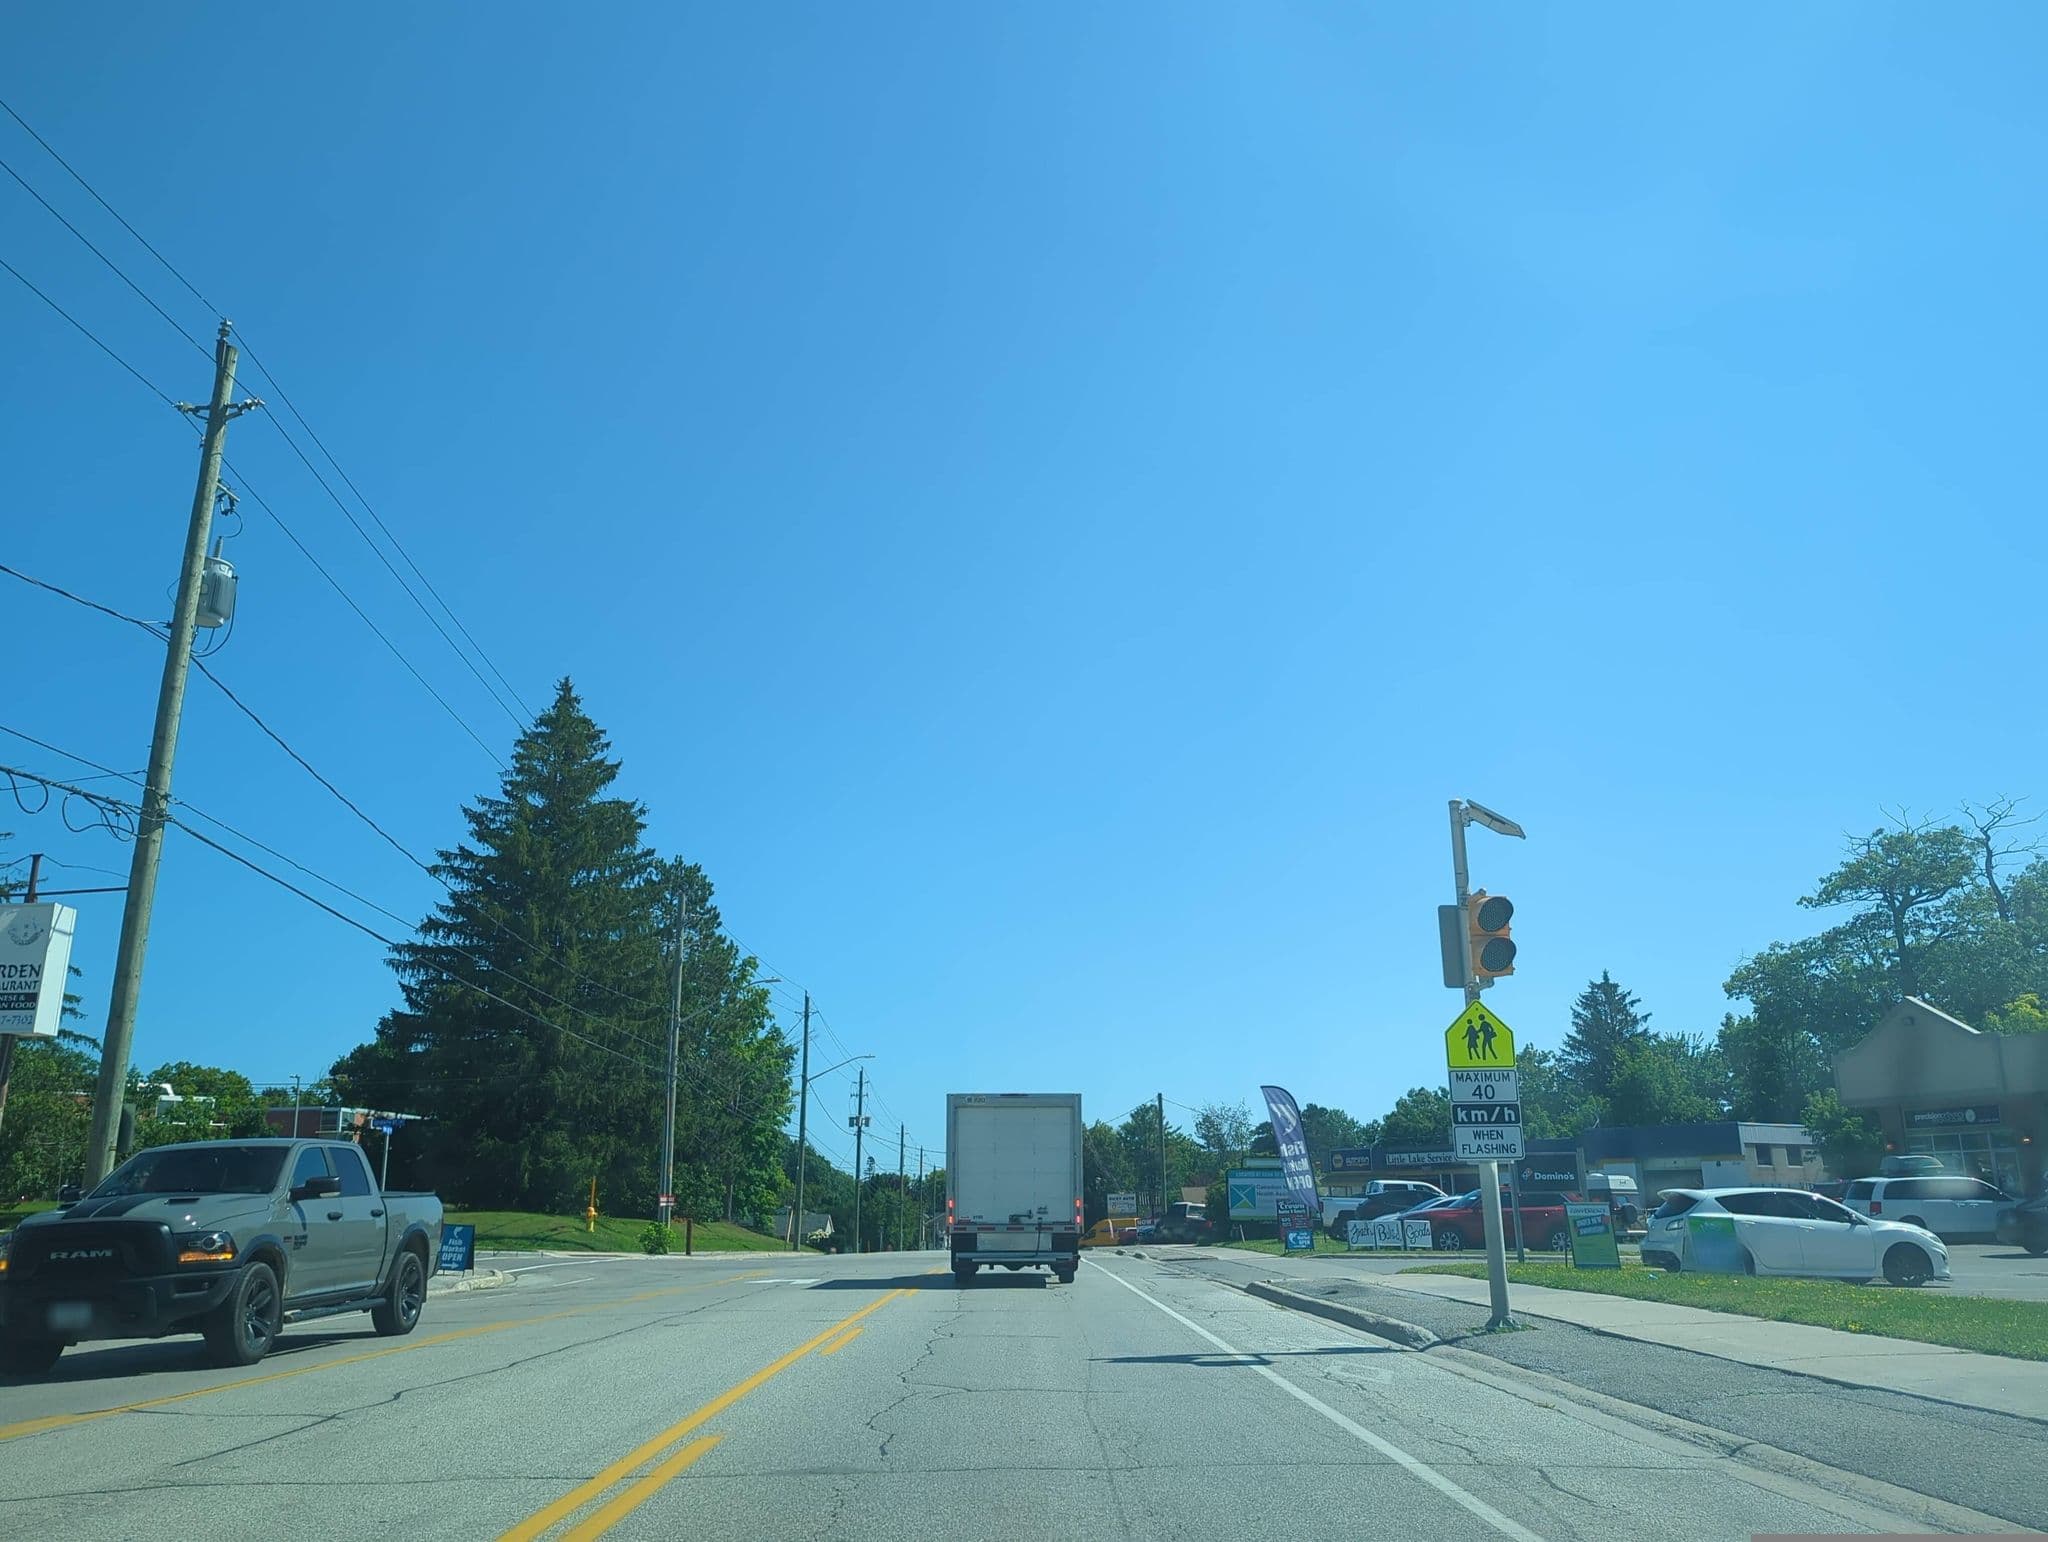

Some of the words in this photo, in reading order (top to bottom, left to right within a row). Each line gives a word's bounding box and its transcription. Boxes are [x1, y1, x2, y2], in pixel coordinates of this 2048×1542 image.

[1455, 1072, 1511, 1083] MAXIMUM
[1471, 1084, 1496, 1100] 40
[1456, 1106, 1516, 1122] km/h
[1472, 1129, 1504, 1141] WHEN
[1461, 1143, 1517, 1155] FLASHING
[1408, 1152, 1425, 1164] Lake
[1427, 1152, 1454, 1163] Service
[1534, 1171, 1575, 1180] Domino's
[448, 1238, 463, 1246] Fish
[49, 1248, 113, 1260] RAM
[441, 1245, 466, 1253] Market
[441, 1252, 464, 1262] OPEN
